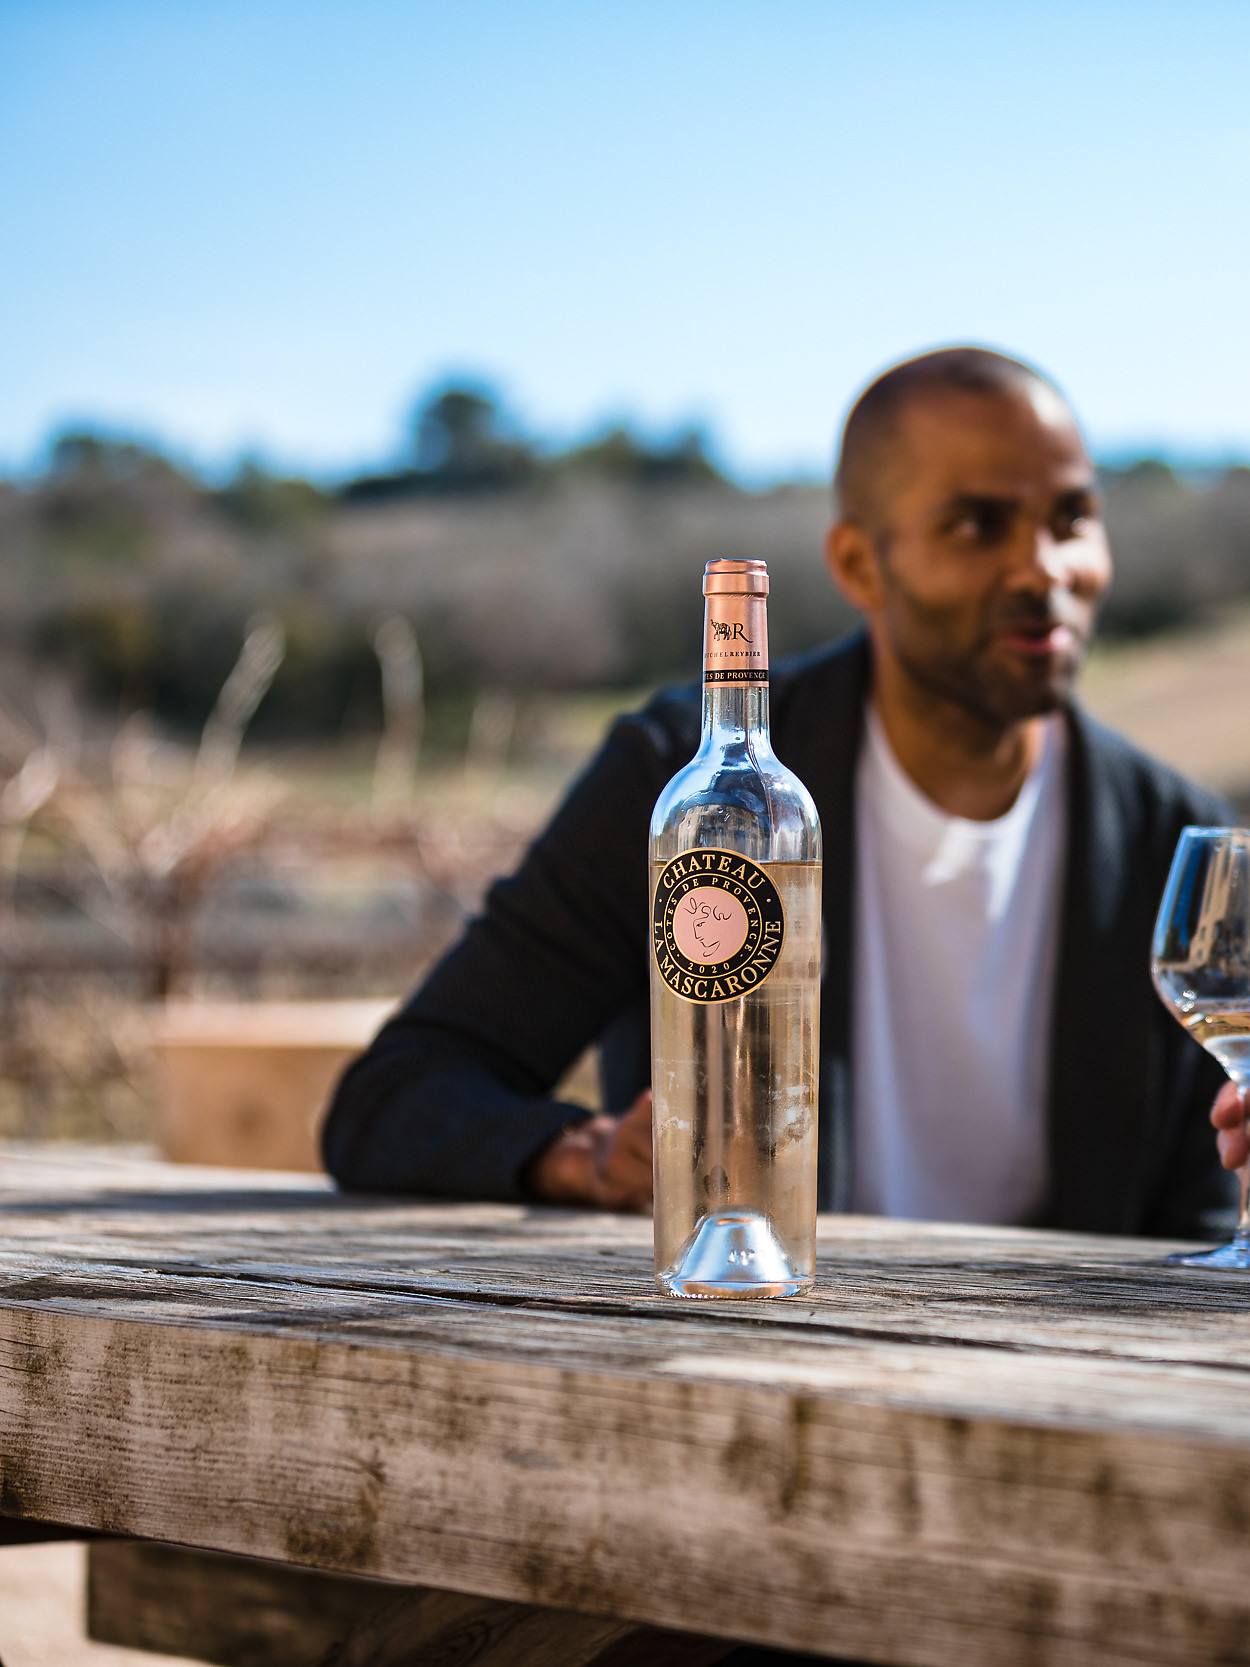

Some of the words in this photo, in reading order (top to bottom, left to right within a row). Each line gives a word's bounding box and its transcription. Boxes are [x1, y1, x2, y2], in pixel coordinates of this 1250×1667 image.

[714, 672, 725, 680] DE
[727, 671, 766, 680] PROVENCE
[662, 854, 766, 890] CHATEAU
[666, 897, 678, 951] COTES
[682, 878, 700, 892] DE
[711, 877, 760, 952] PROVENCE
[655, 920, 665, 954] LA
[660, 920, 781, 999] MASCARONNE
[687, 962, 730, 974] 2020
